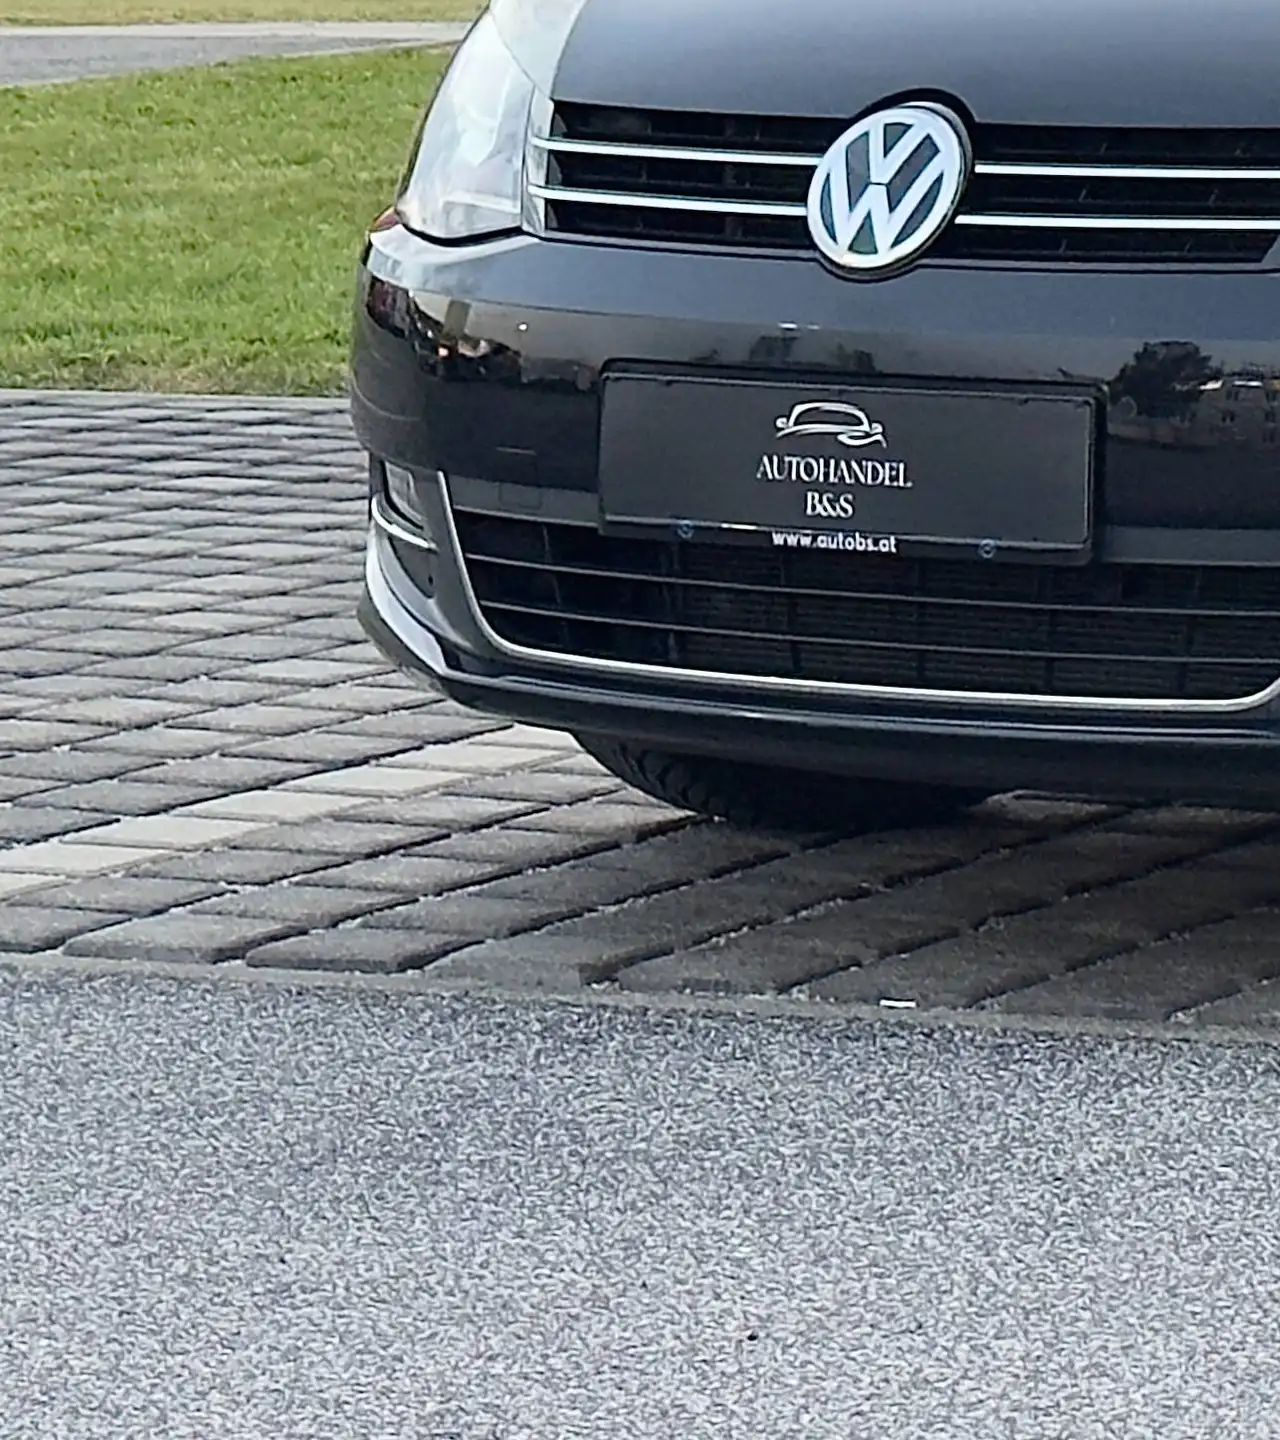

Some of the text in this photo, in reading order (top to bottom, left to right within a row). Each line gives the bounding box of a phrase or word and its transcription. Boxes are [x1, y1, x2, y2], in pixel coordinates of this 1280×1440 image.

[808, 109, 962, 268] VW
[756, 454, 913, 488] AUTOHANDEL
[805, 490, 855, 519] B&S
[771, 531, 898, 554] www.autobs.at
